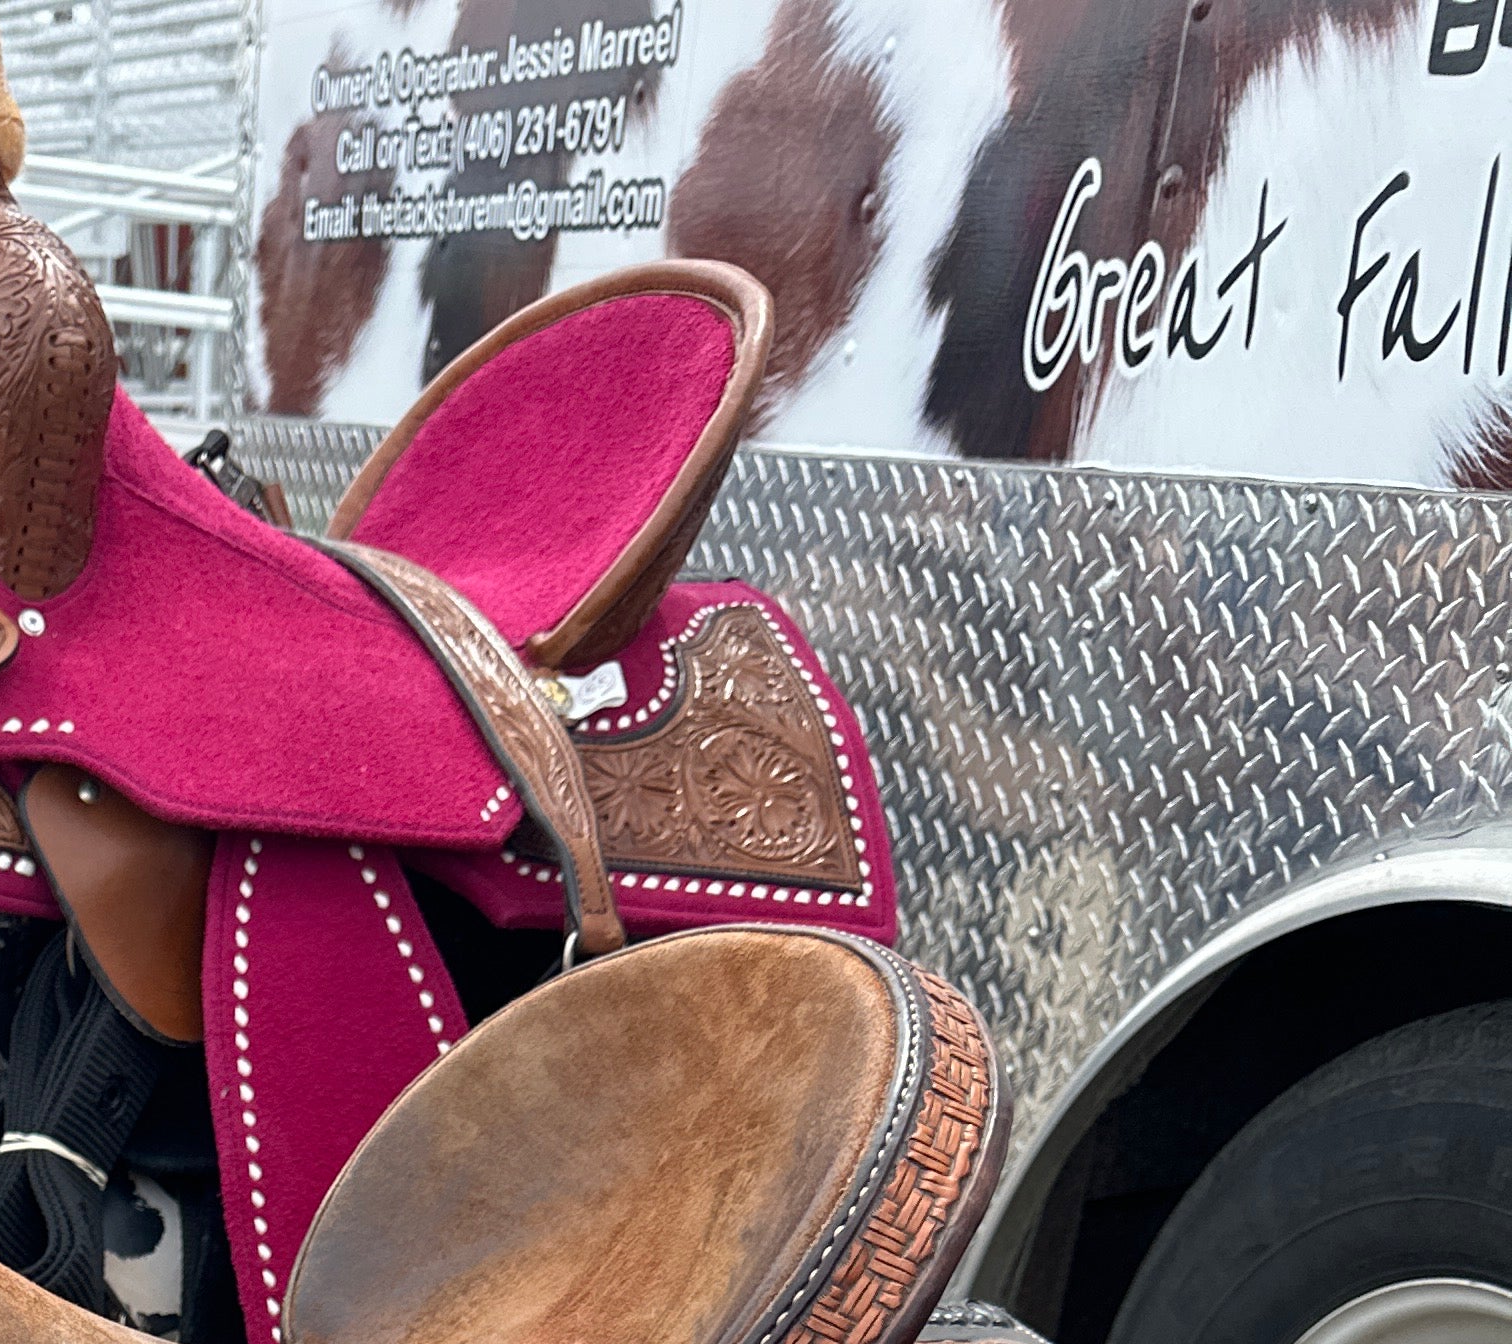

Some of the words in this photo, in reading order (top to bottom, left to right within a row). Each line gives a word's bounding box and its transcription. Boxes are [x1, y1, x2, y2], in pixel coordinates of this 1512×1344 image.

[312, 64, 374, 113] Owner
[373, 51, 392, 106] &
[394, 49, 498, 114] Operator:
[500, 27, 575, 84] Jessie
[577, 3, 682, 73] Marreel
[337, 125, 376, 174] Call
[376, 131, 402, 169] or
[404, 116, 456, 172] Text:
[457, 109, 513, 173] (406)
[514, 94, 626, 156] 231-6791
[303, 193, 360, 242] Email:
[361, 169, 665, 242] thetackstoremt@gmail.com
[1026, 160, 1288, 388] Great
